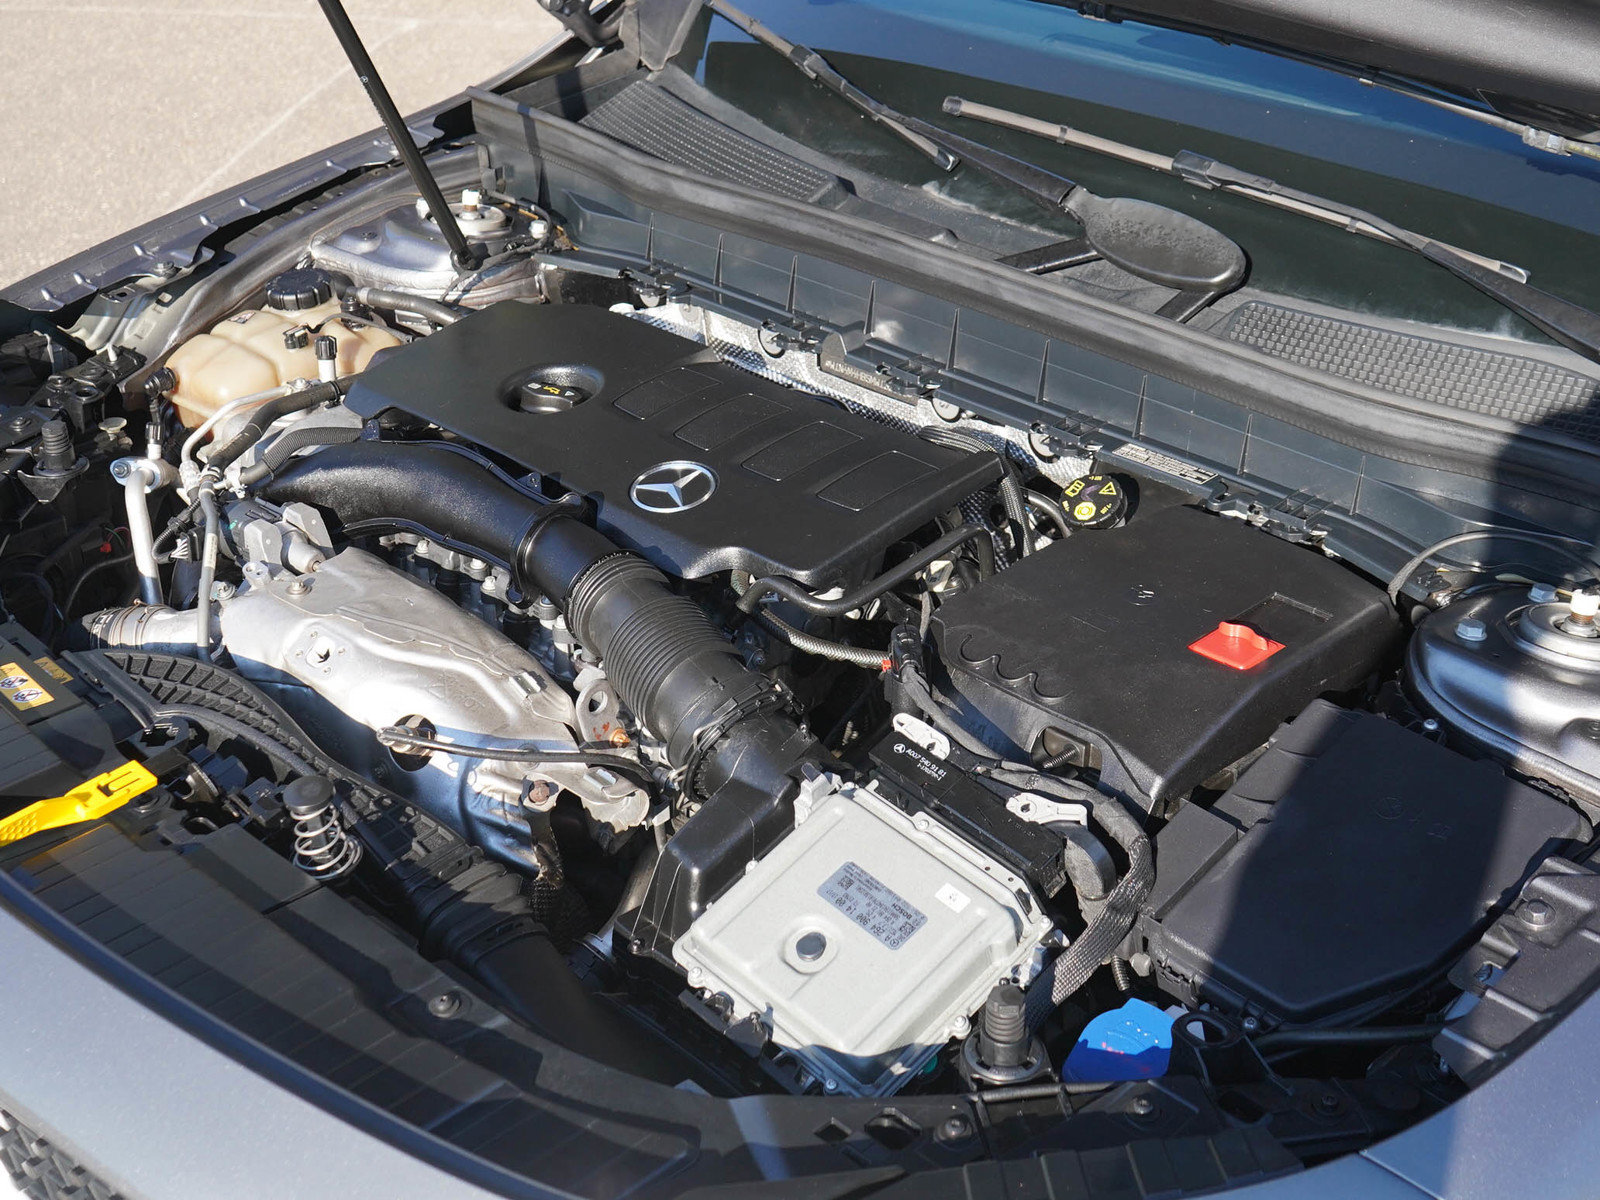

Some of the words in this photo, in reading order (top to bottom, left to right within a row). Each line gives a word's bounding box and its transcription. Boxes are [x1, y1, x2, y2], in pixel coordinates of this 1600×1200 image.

[920, 757, 931, 766] 540
[930, 764, 939, 772] 91
[938, 769, 947, 777] 81
[846, 906, 857, 915] 14
[892, 903, 912, 919] BOSCH
[856, 913, 870, 925] 900
[870, 924, 885, 937] 264
